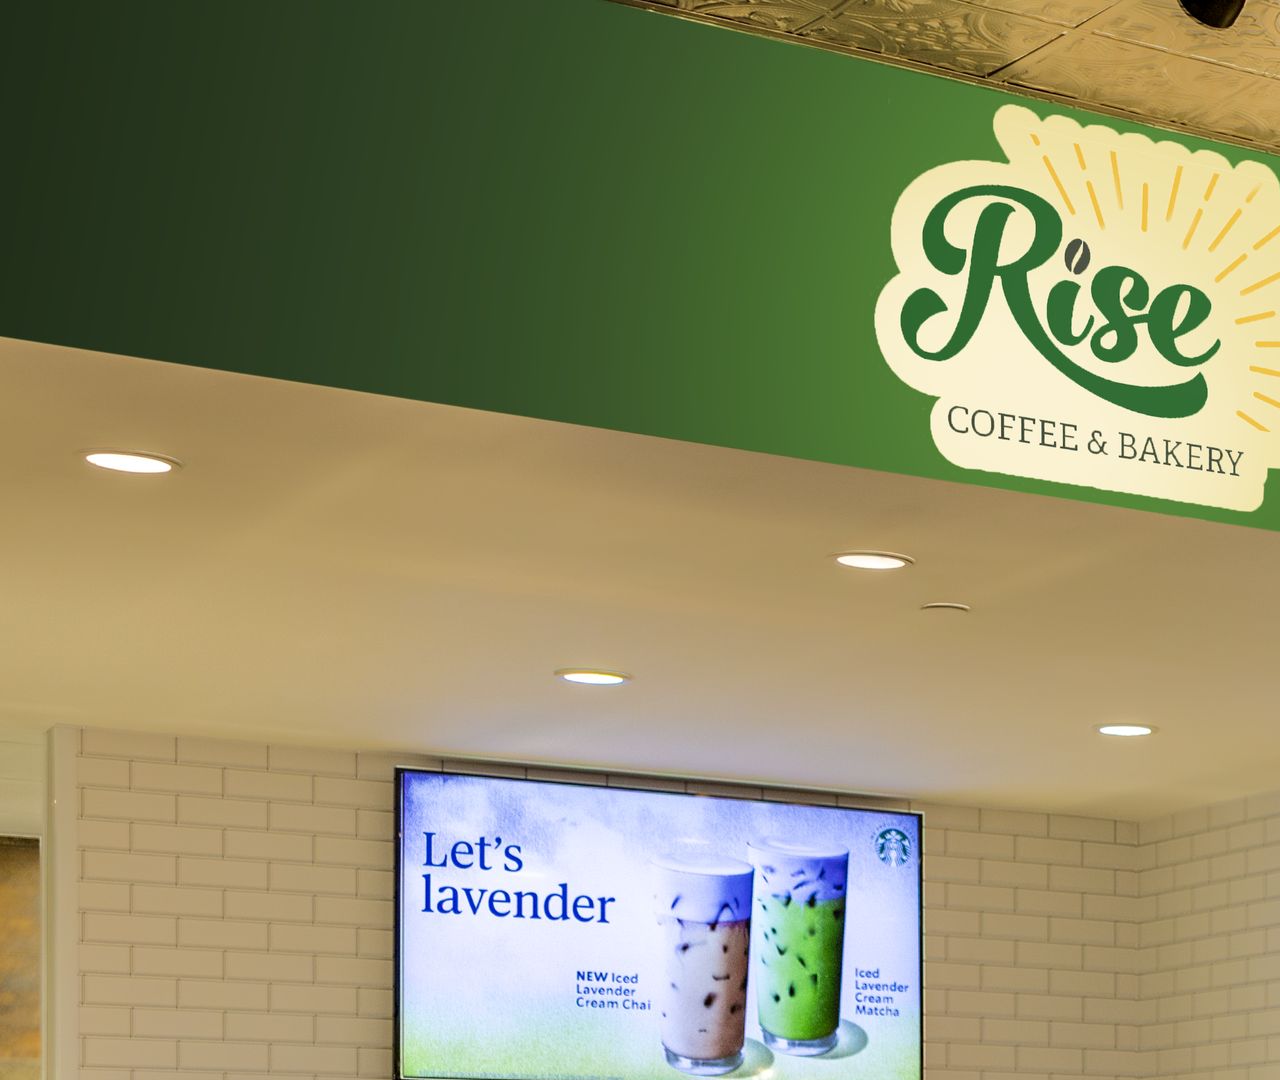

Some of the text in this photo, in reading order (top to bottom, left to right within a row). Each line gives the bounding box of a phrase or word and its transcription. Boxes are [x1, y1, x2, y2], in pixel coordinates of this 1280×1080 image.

[900, 184, 1221, 419] Rise
[947, 405, 1244, 477] COFFEE & BAKERY
[421, 873, 617, 925] lavender
[575, 970, 639, 984] NEW Iced
[854, 967, 880, 979] Iced
[575, 984, 636, 997] Lavender
[855, 980, 910, 993] Lavender
[575, 997, 652, 1011] Cream Chai
[855, 992, 894, 1004] Cream
[855, 1005, 900, 1017] Matcha
